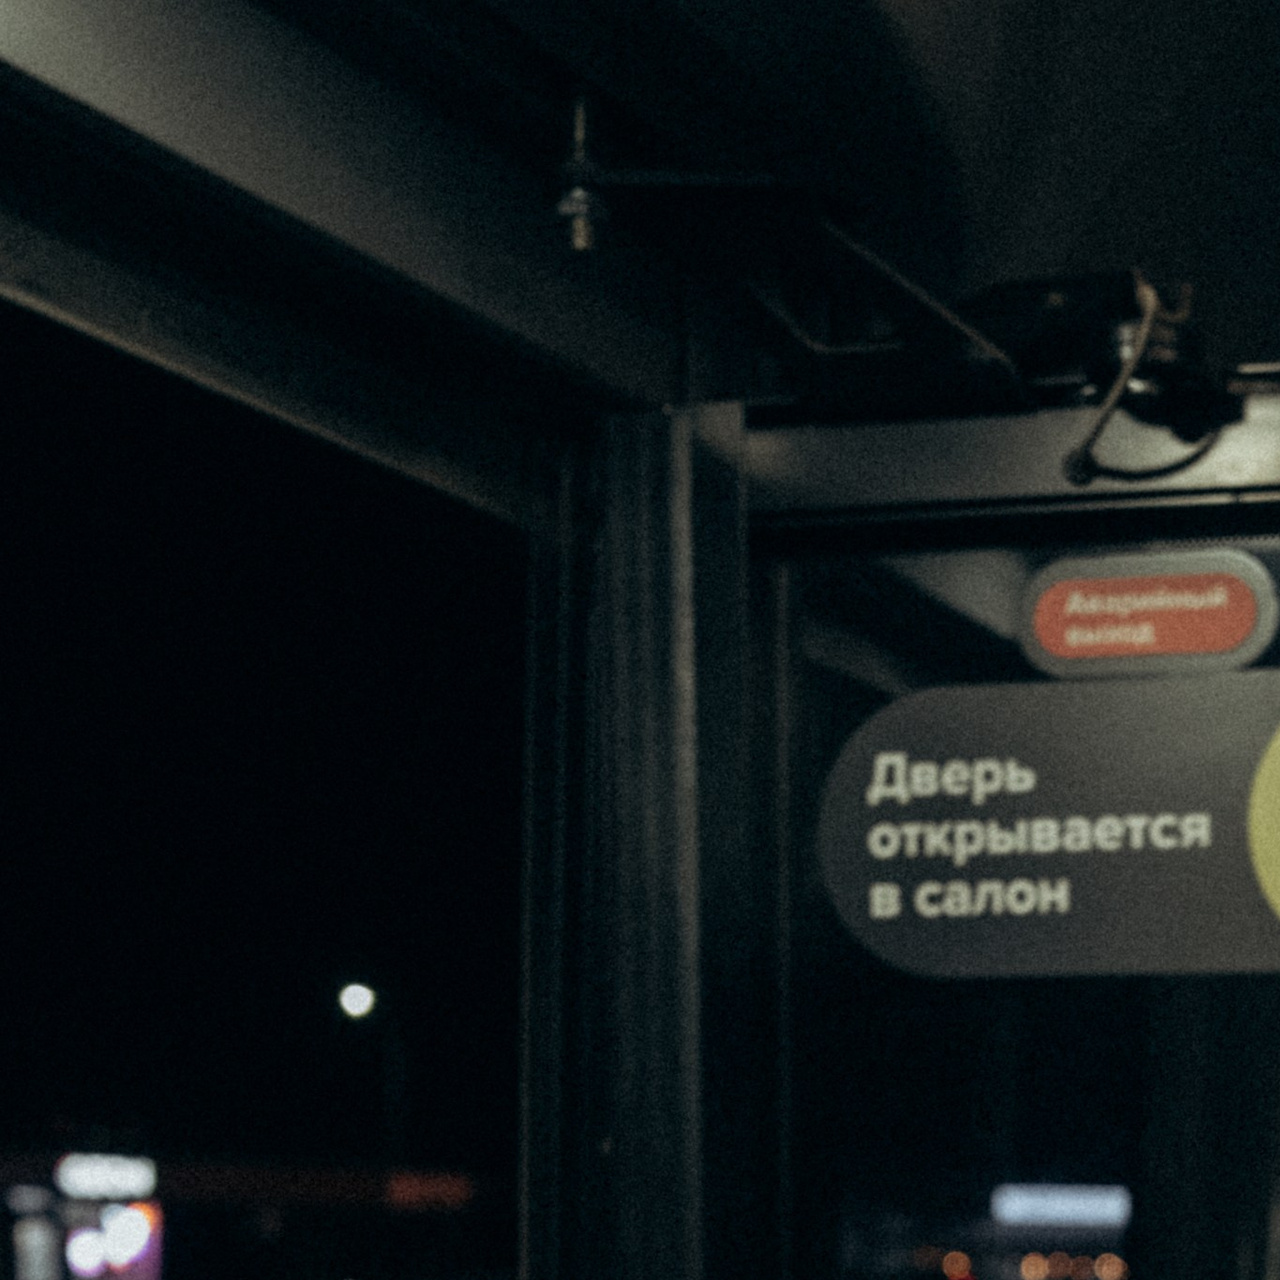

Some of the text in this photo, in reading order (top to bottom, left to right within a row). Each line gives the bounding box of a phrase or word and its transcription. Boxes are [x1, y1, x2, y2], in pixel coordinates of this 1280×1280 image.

[868, 752, 1036, 805] Дверь
[867, 813, 1212, 866] открывается
[870, 877, 1072, 919] в салон
